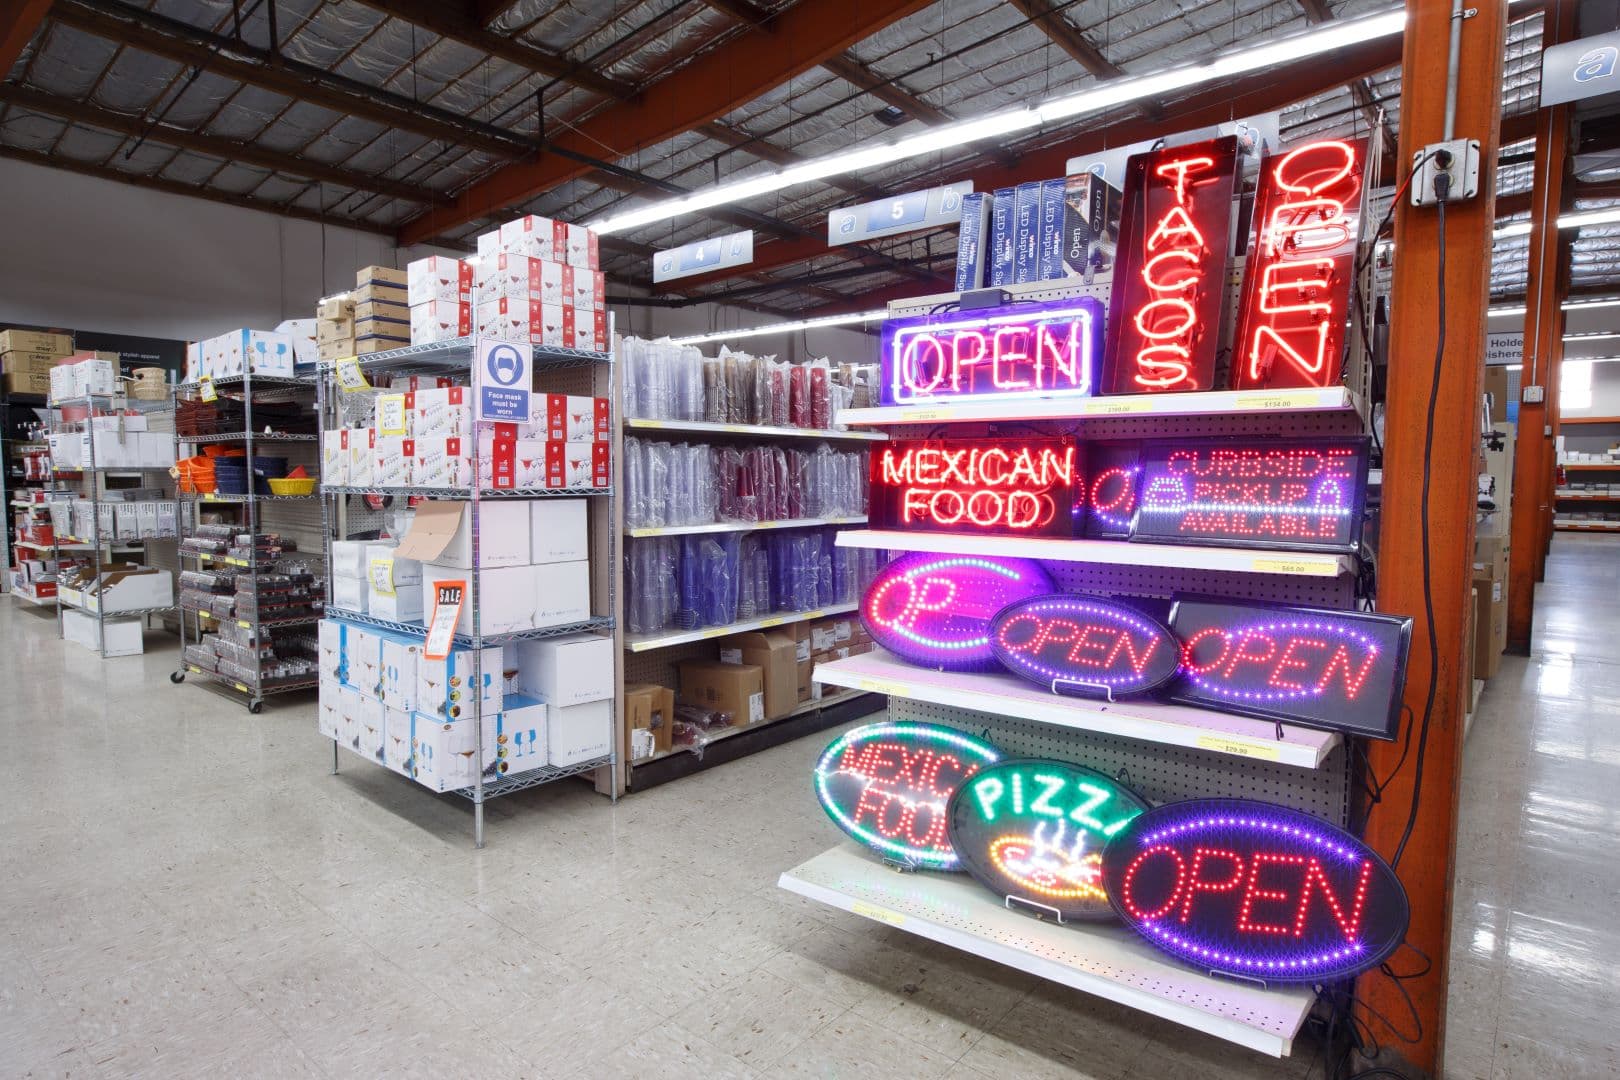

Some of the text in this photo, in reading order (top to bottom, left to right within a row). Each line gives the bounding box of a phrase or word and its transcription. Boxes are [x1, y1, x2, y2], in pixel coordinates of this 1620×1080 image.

[890, 204, 904, 220] 5
[964, 213, 973, 235] LED
[1093, 189, 1102, 232] Open
[695, 246, 705, 261] 4
[960, 236, 972, 273] Display
[992, 209, 1006, 287] LED Display Sig
[1017, 205, 1030, 283] LED Display Sig
[1041, 201, 1055, 281] LED Display Sig
[1070, 227, 1083, 259] Open
[1134, 156, 1214, 387] TACOS
[1249, 139, 1356, 382] OPEN
[902, 320, 1079, 394] OPEN
[1485, 350, 1523, 359] ishers
[1490, 338, 1524, 348] Holde
[488, 391, 522, 401] Face mask
[492, 400, 509, 408] must
[496, 408, 513, 416] worn
[882, 446, 1075, 486] MEXICAN
[1167, 449, 1353, 478] CURBSIDE
[904, 487, 1041, 528] FOOD
[1193, 482, 1309, 508] PICKUP
[1179, 511, 1339, 538] AVAILABLE
[440, 587, 461, 603] SALE
[1000, 612, 1161, 674] OPEN
[1182, 627, 1379, 700] OPEN
[838, 742, 979, 798] MEXIC
[973, 772, 1144, 836] PIZZ
[1122, 844, 1373, 945] OPEN
